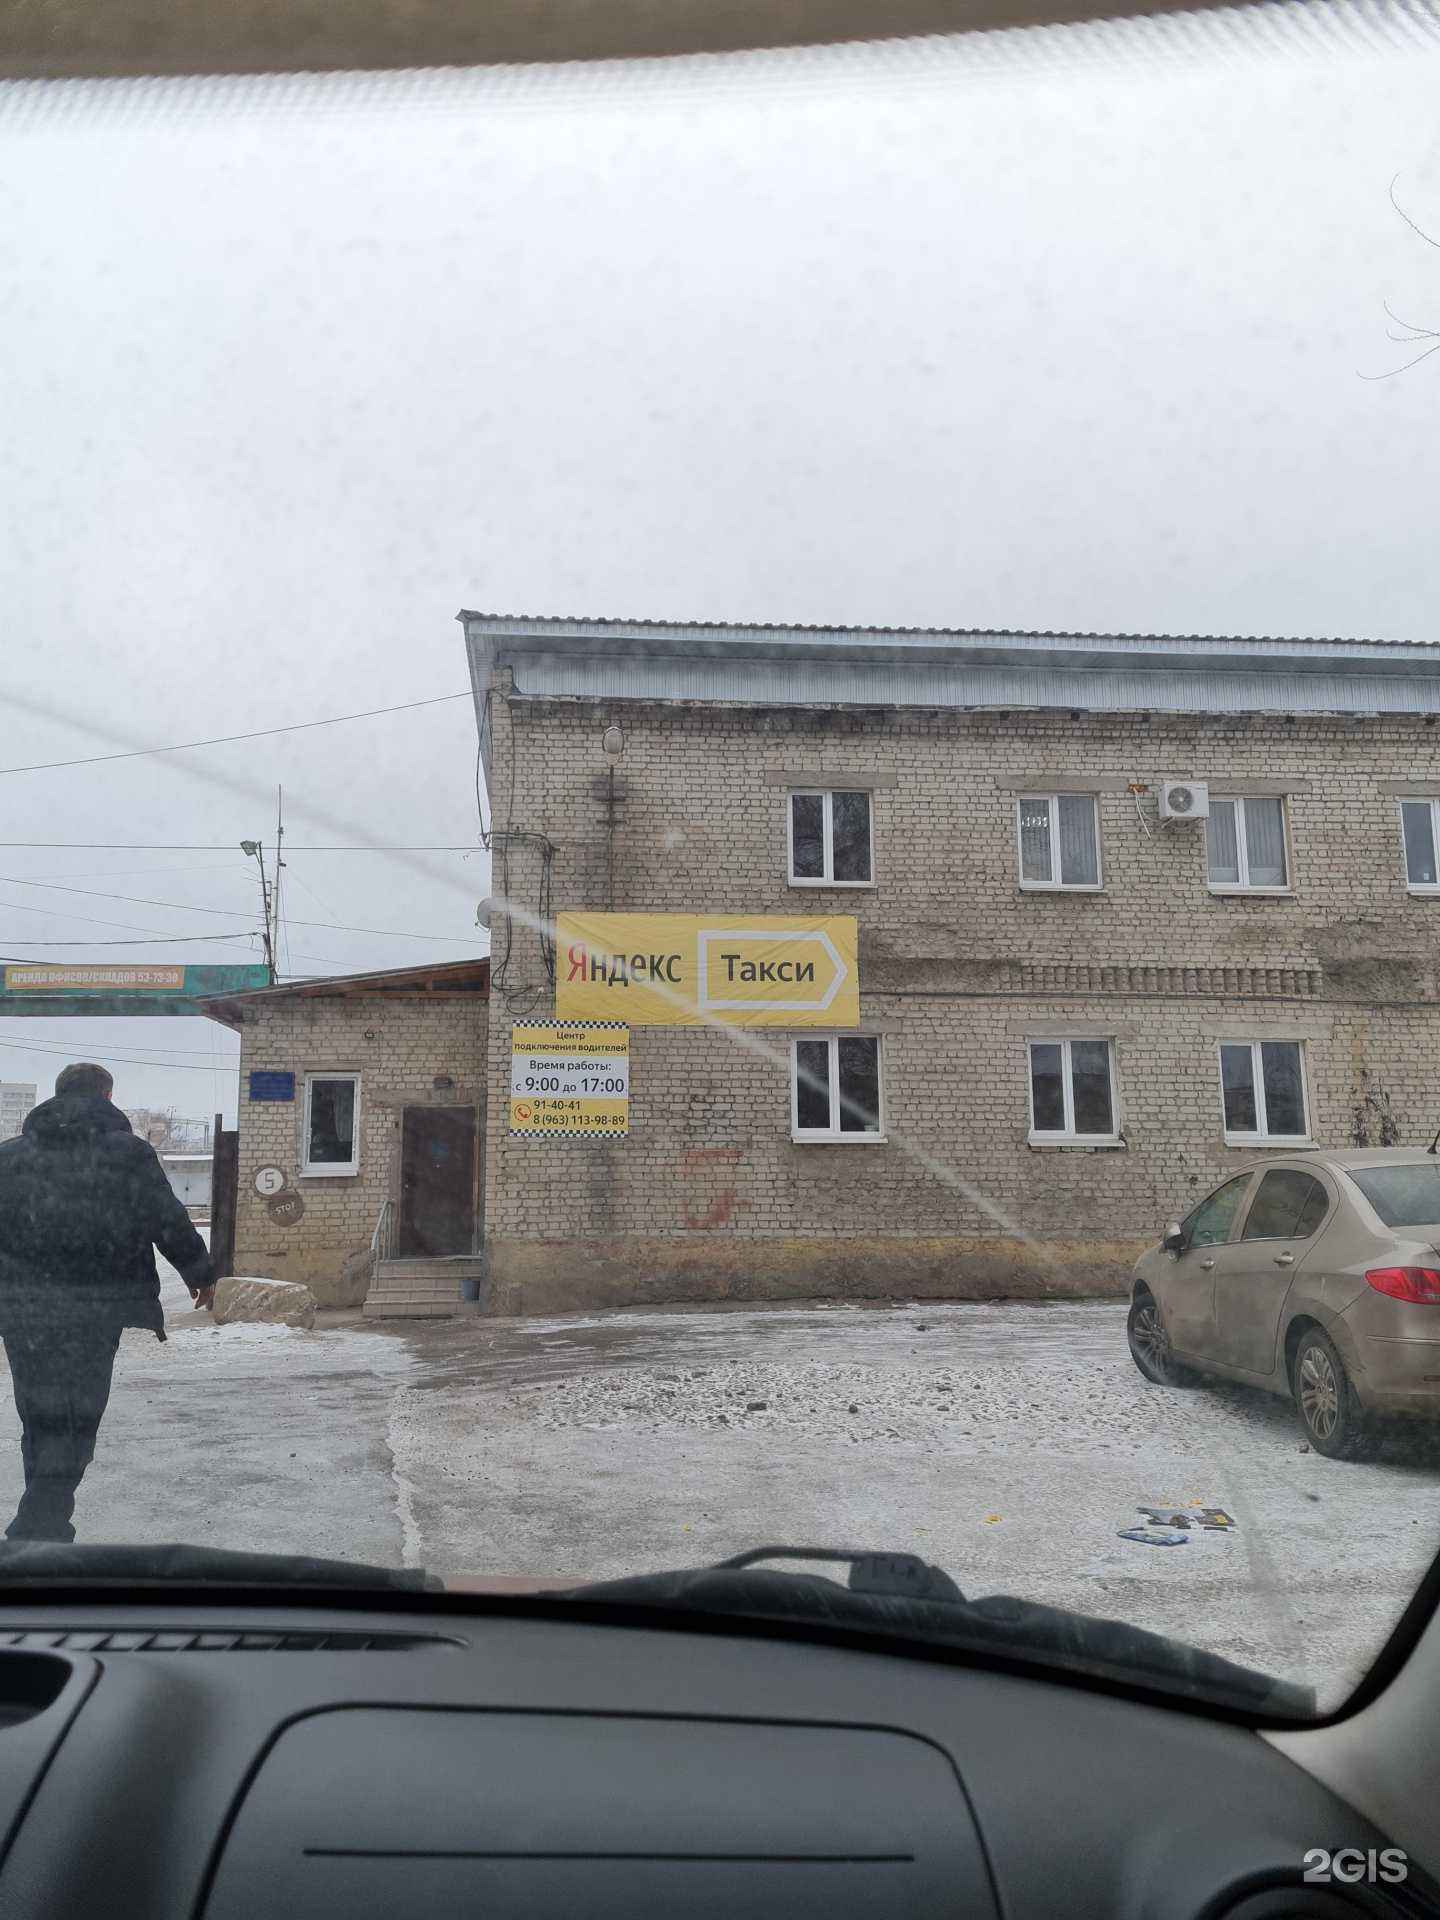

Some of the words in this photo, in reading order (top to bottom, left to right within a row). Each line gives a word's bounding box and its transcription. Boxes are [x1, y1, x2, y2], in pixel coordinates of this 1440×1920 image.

[566, 941, 683, 987] Яндекс
[720, 954, 815, 982] Такси
[556, 1032, 586, 1040] Центр
[514, 1043, 577, 1052] подключения
[578, 1042, 627, 1052] водителей
[529, 1060, 565, 1071] Время
[567, 1061, 612, 1071] работы:
[515, 1083, 522, 1091] с
[525, 1077, 559, 1091] 9:00
[563, 1083, 577, 1093] до
[581, 1078, 625, 1092] 17:00
[533, 1100, 581, 1110] 91-40-41
[533, 1115, 540, 1124] 8
[542, 1115, 569, 1126] (963)
[573, 1115, 625, 1125] 113-98-89
[264, 1172, 275, 1189] 5
